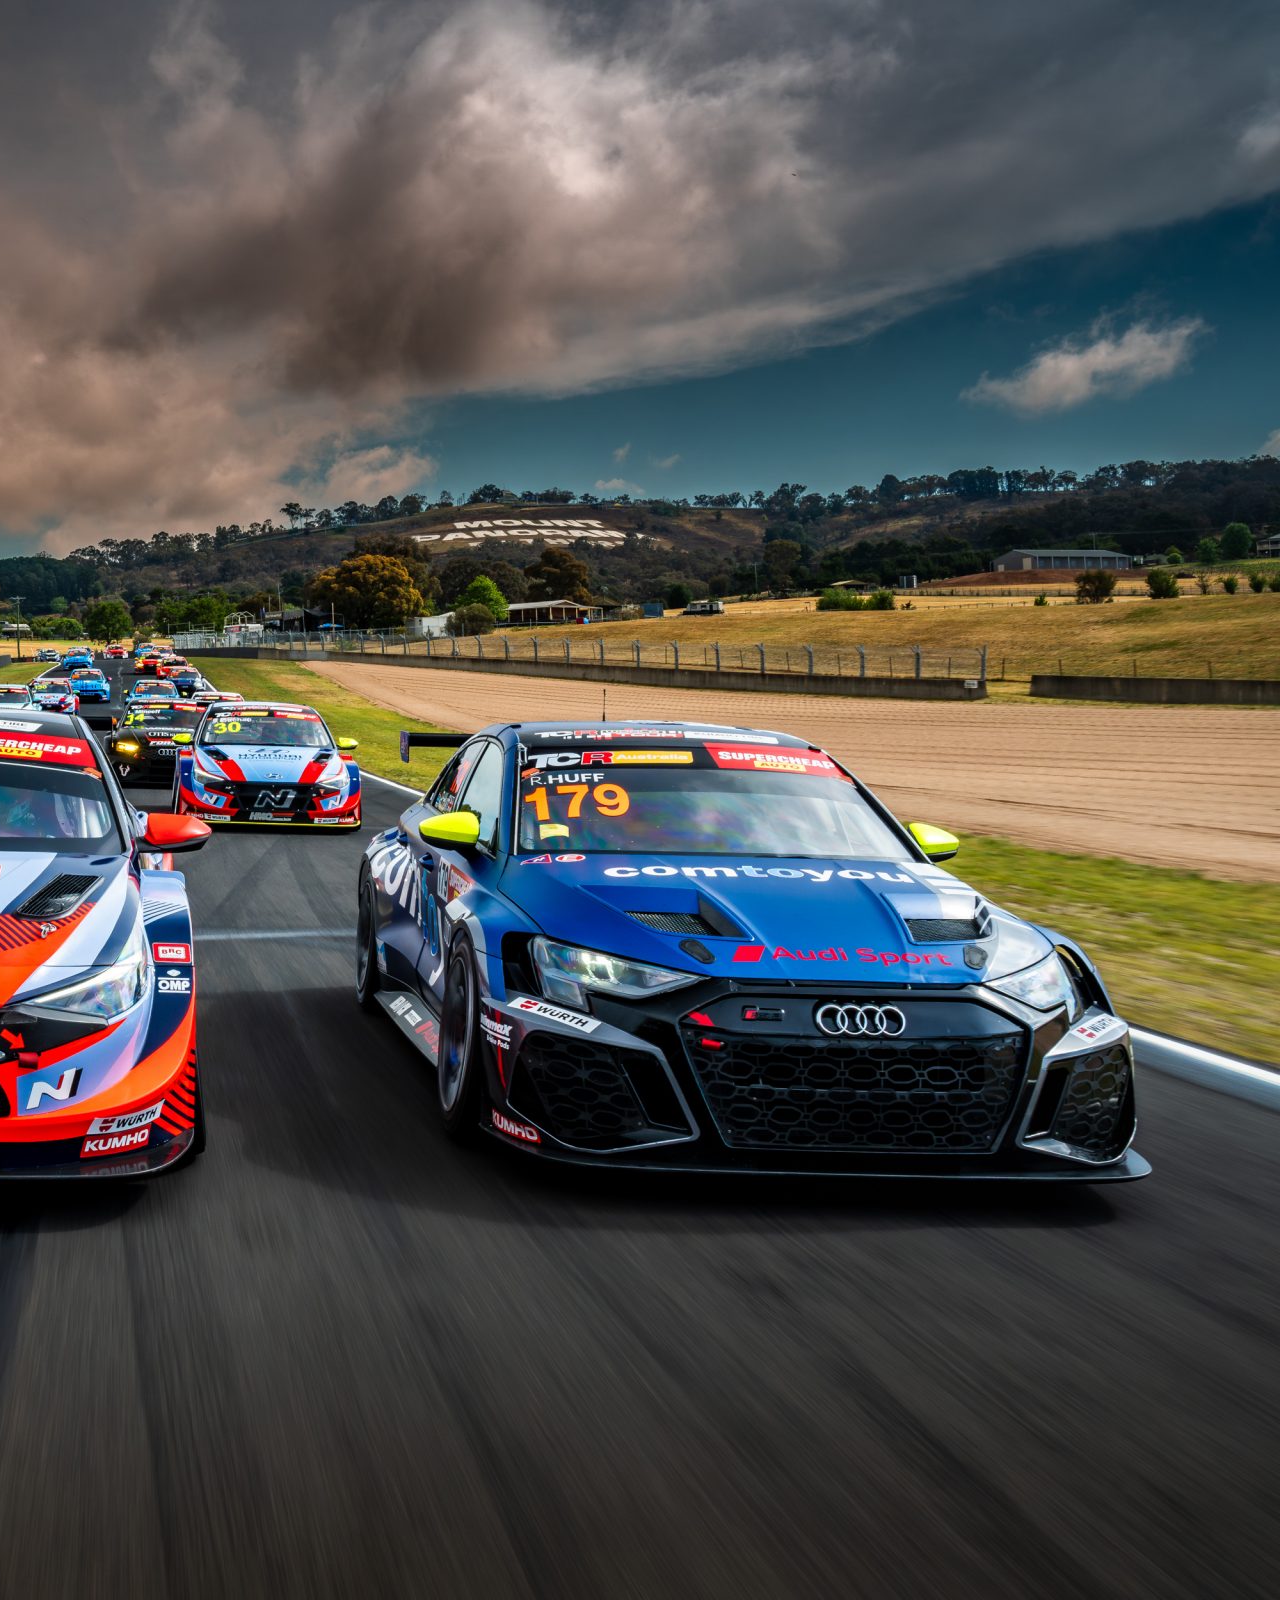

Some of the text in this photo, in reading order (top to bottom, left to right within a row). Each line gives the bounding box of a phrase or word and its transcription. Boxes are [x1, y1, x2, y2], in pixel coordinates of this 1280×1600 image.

[453, 519, 606, 528] MOUNT
[124, 713, 145, 725] 14
[213, 721, 241, 734] 30
[528, 751, 615, 769] TCR
[717, 750, 836, 770] SUPERCHEAP
[525, 782, 630, 821] 179
[603, 865, 916, 884] comtoyou
[771, 946, 954, 966] Audi Sport
[158, 980, 191, 991] OMP
[84, 1131, 149, 1153] KUMHO
